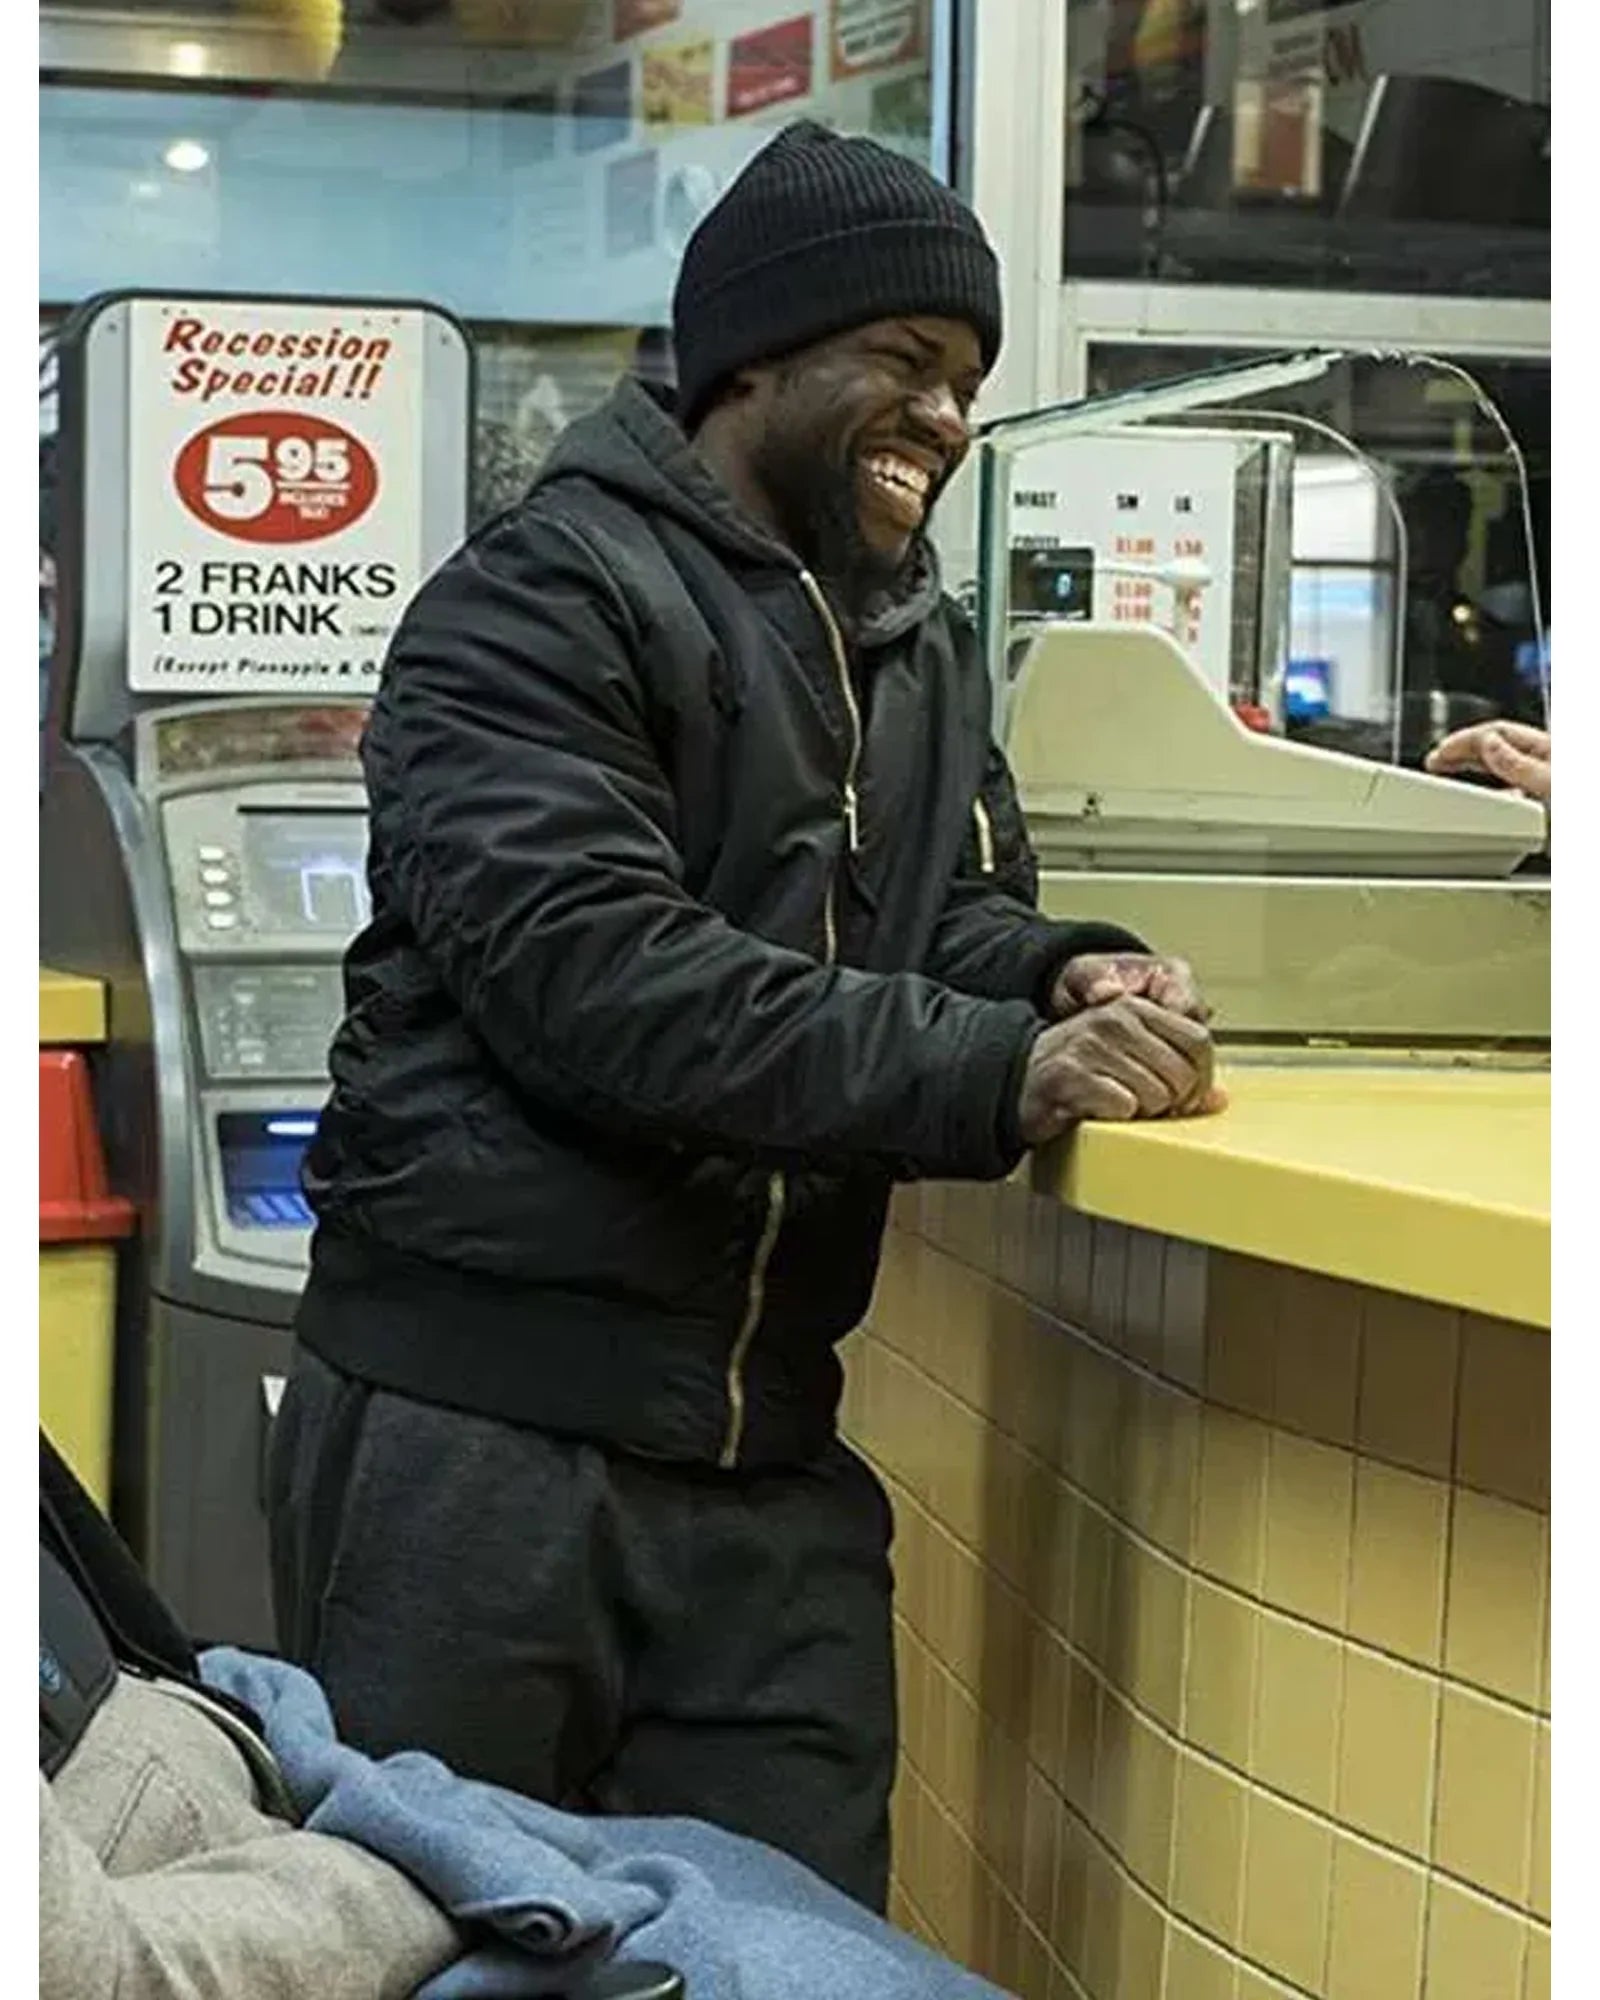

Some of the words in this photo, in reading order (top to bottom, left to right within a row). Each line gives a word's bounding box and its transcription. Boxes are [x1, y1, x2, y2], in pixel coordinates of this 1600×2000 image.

[163, 318, 391, 361] Recession
[155, 560, 184, 595] 2
[200, 561, 397, 598] FRANKS
[152, 601, 172, 635] 1
[190, 601, 342, 635] DRINK
